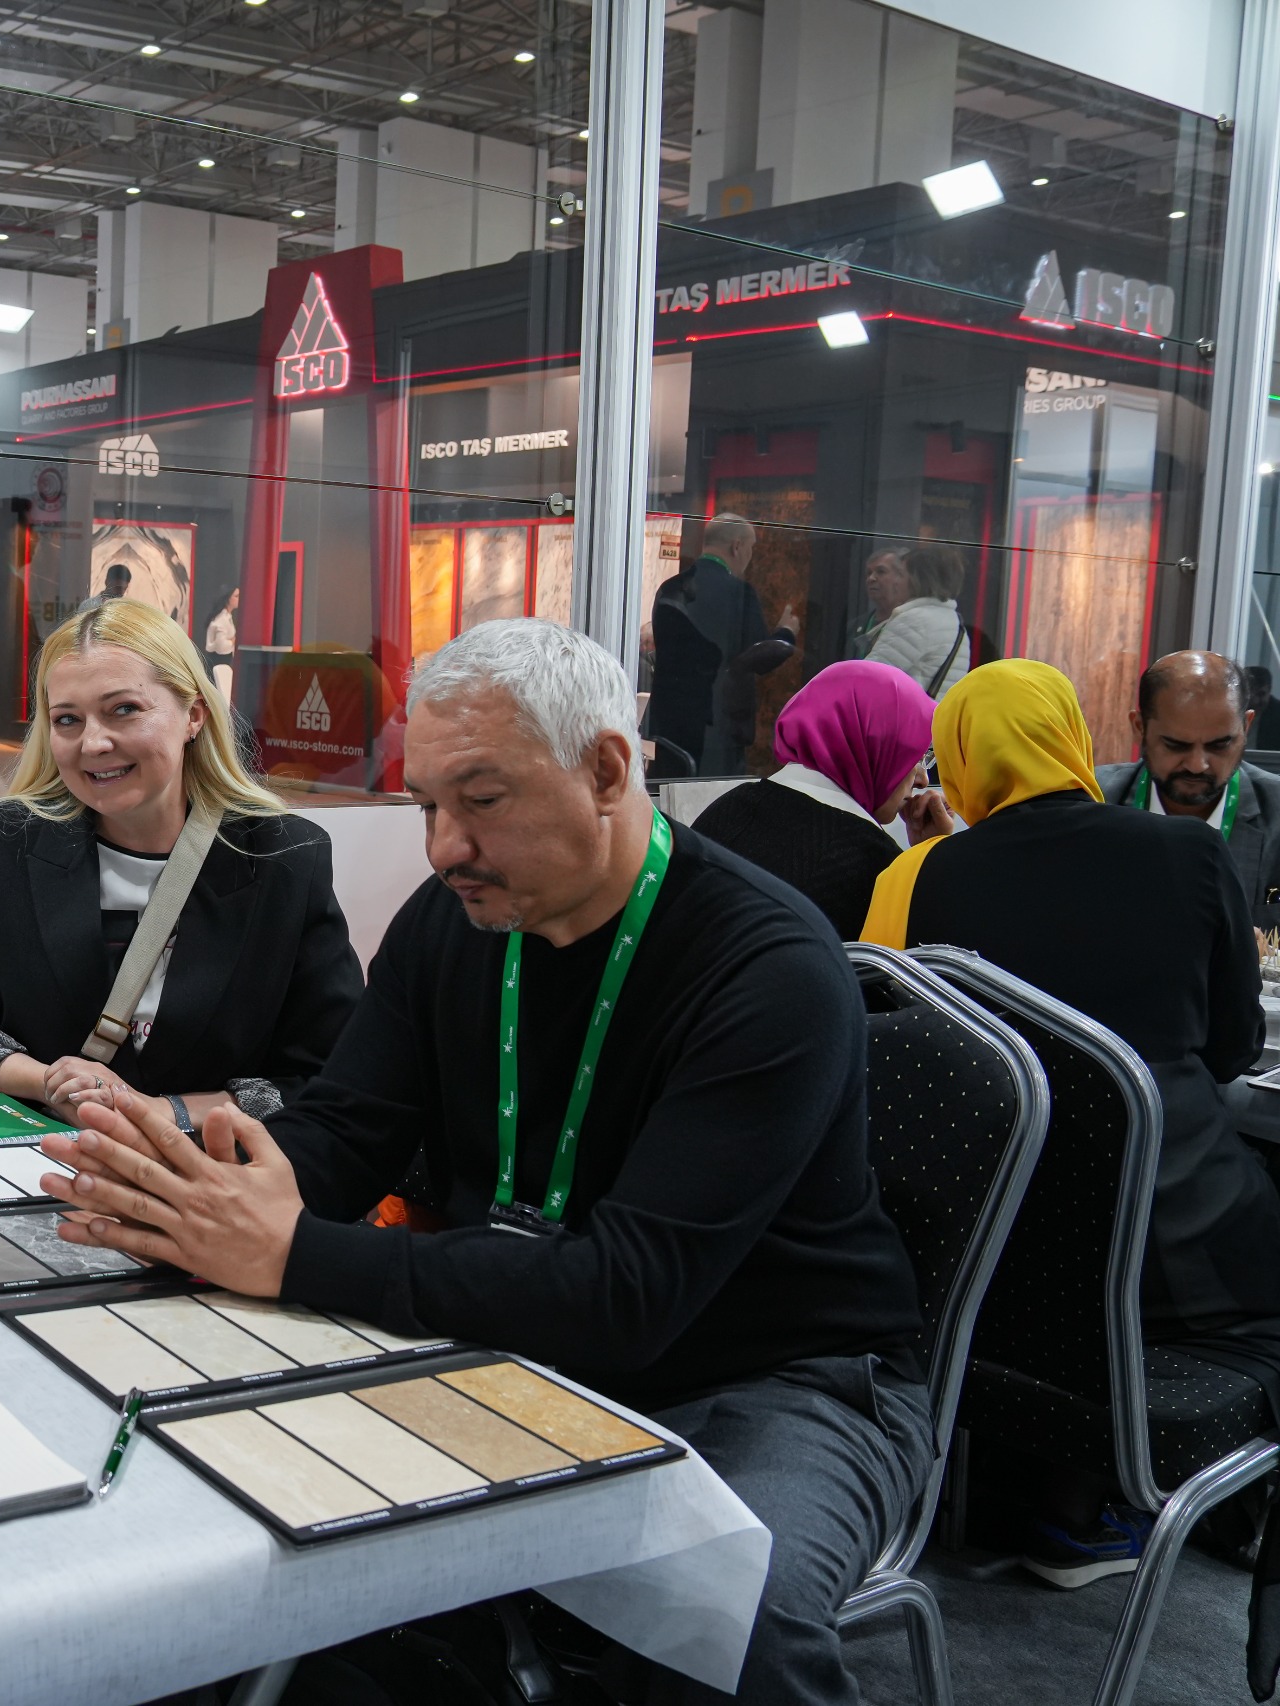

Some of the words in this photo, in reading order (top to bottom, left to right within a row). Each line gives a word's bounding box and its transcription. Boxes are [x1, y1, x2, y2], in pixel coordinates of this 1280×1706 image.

[716, 260, 851, 306] MERMER
[1074, 268, 1174, 340] ISCO
[274, 350, 349, 398] ISCO
[21, 374, 116, 412] POURHASSANI
[1053, 395, 1106, 413] GROUP
[420, 442, 458, 460] ISCO
[461, 438, 492, 457] TAŞ
[494, 429, 569, 453] MERMER
[98, 448, 160, 477] ISCO
[296, 711, 331, 732] ISCO
